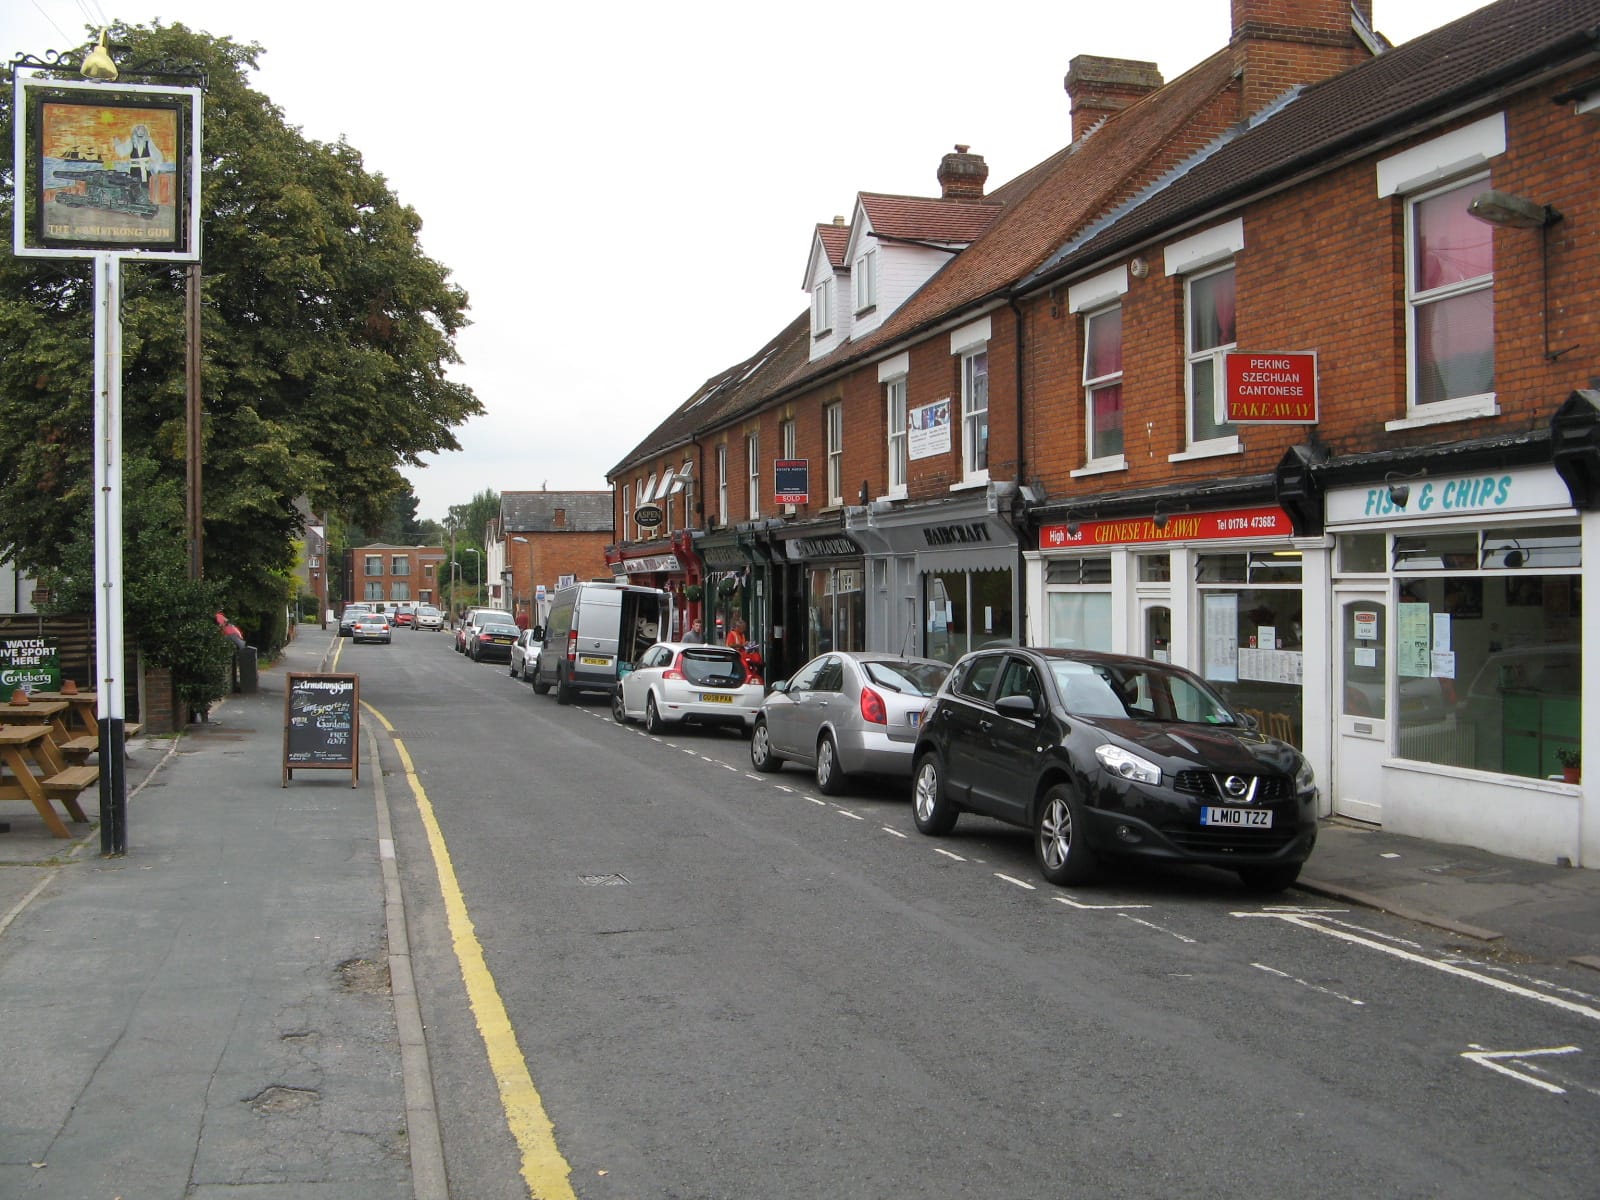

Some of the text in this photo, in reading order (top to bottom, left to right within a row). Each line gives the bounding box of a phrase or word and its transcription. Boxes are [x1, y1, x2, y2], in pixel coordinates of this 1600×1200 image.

[48, 224, 70, 234] THE
[147, 227, 170, 238] GUN
[1250, 359, 1290, 370] PEKING
[1242, 372, 1300, 383] SZECHUAN
[1238, 385, 1303, 396] CANTONESE
[1230, 402, 1312, 417] TAKEAWAY
[1364, 475, 1512, 516] FIS & CHIPS
[923, 521, 992, 547] HAIRCRAFT
[1049, 530, 1064, 544] High
[1066, 530, 1082, 541] Rse
[1095, 522, 1141, 543] CHINESE
[1217, 519, 1227, 531] Tel
[1228, 517, 1248, 530] 01784
[1250, 515, 1276, 528] 473682
[6, 640, 45, 648] WATCH
[0, 648, 56, 657] IVE SPORT
[12, 656, 40, 665] HERE
[1, 669, 52, 686] Carlsberg
[1244, 811, 1268, 825] TZZ
